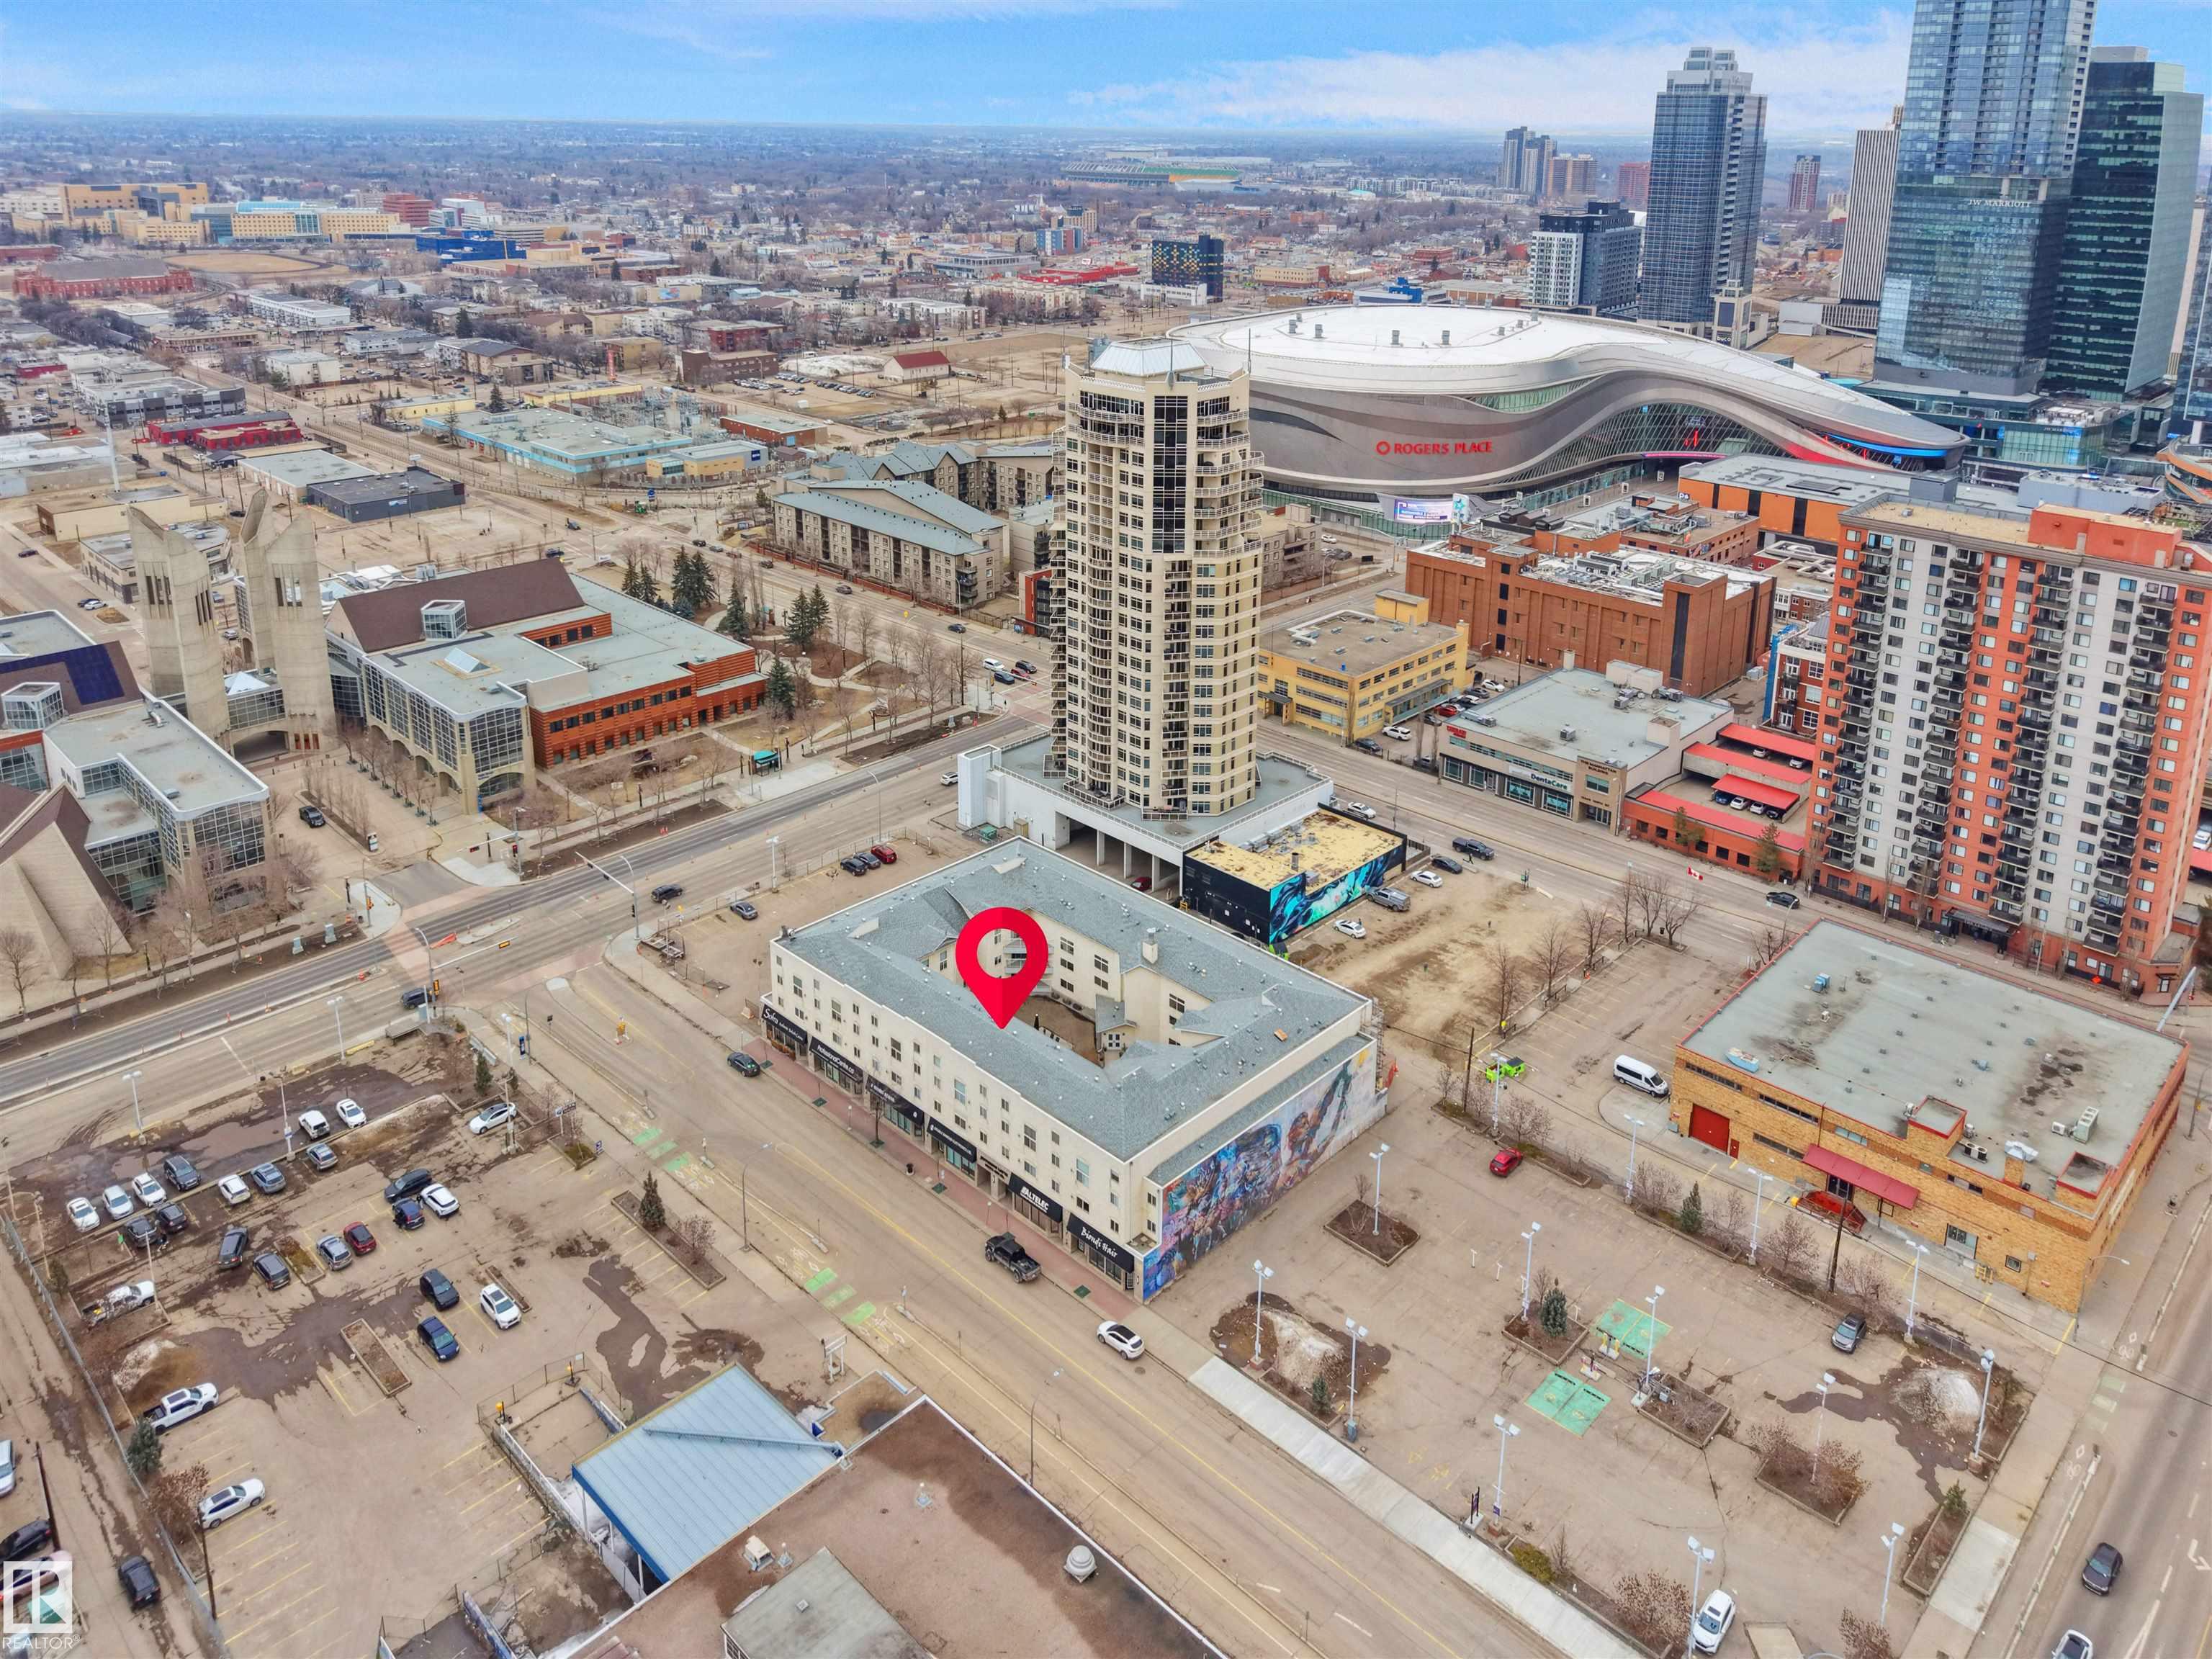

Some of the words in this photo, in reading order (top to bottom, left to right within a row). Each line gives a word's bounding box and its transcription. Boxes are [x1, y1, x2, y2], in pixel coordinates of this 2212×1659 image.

[1394, 443, 1449, 455] ROGERS
[1454, 441, 1493, 454] PLACE
[1531, 773, 1568, 790] DentaCare
[763, 1008, 778, 1024] Sofra
[1022, 1187, 1049, 1210] ALTELEC
[1081, 1226, 1102, 1249] Biondi
[1102, 1242, 1118, 1258] Hair
